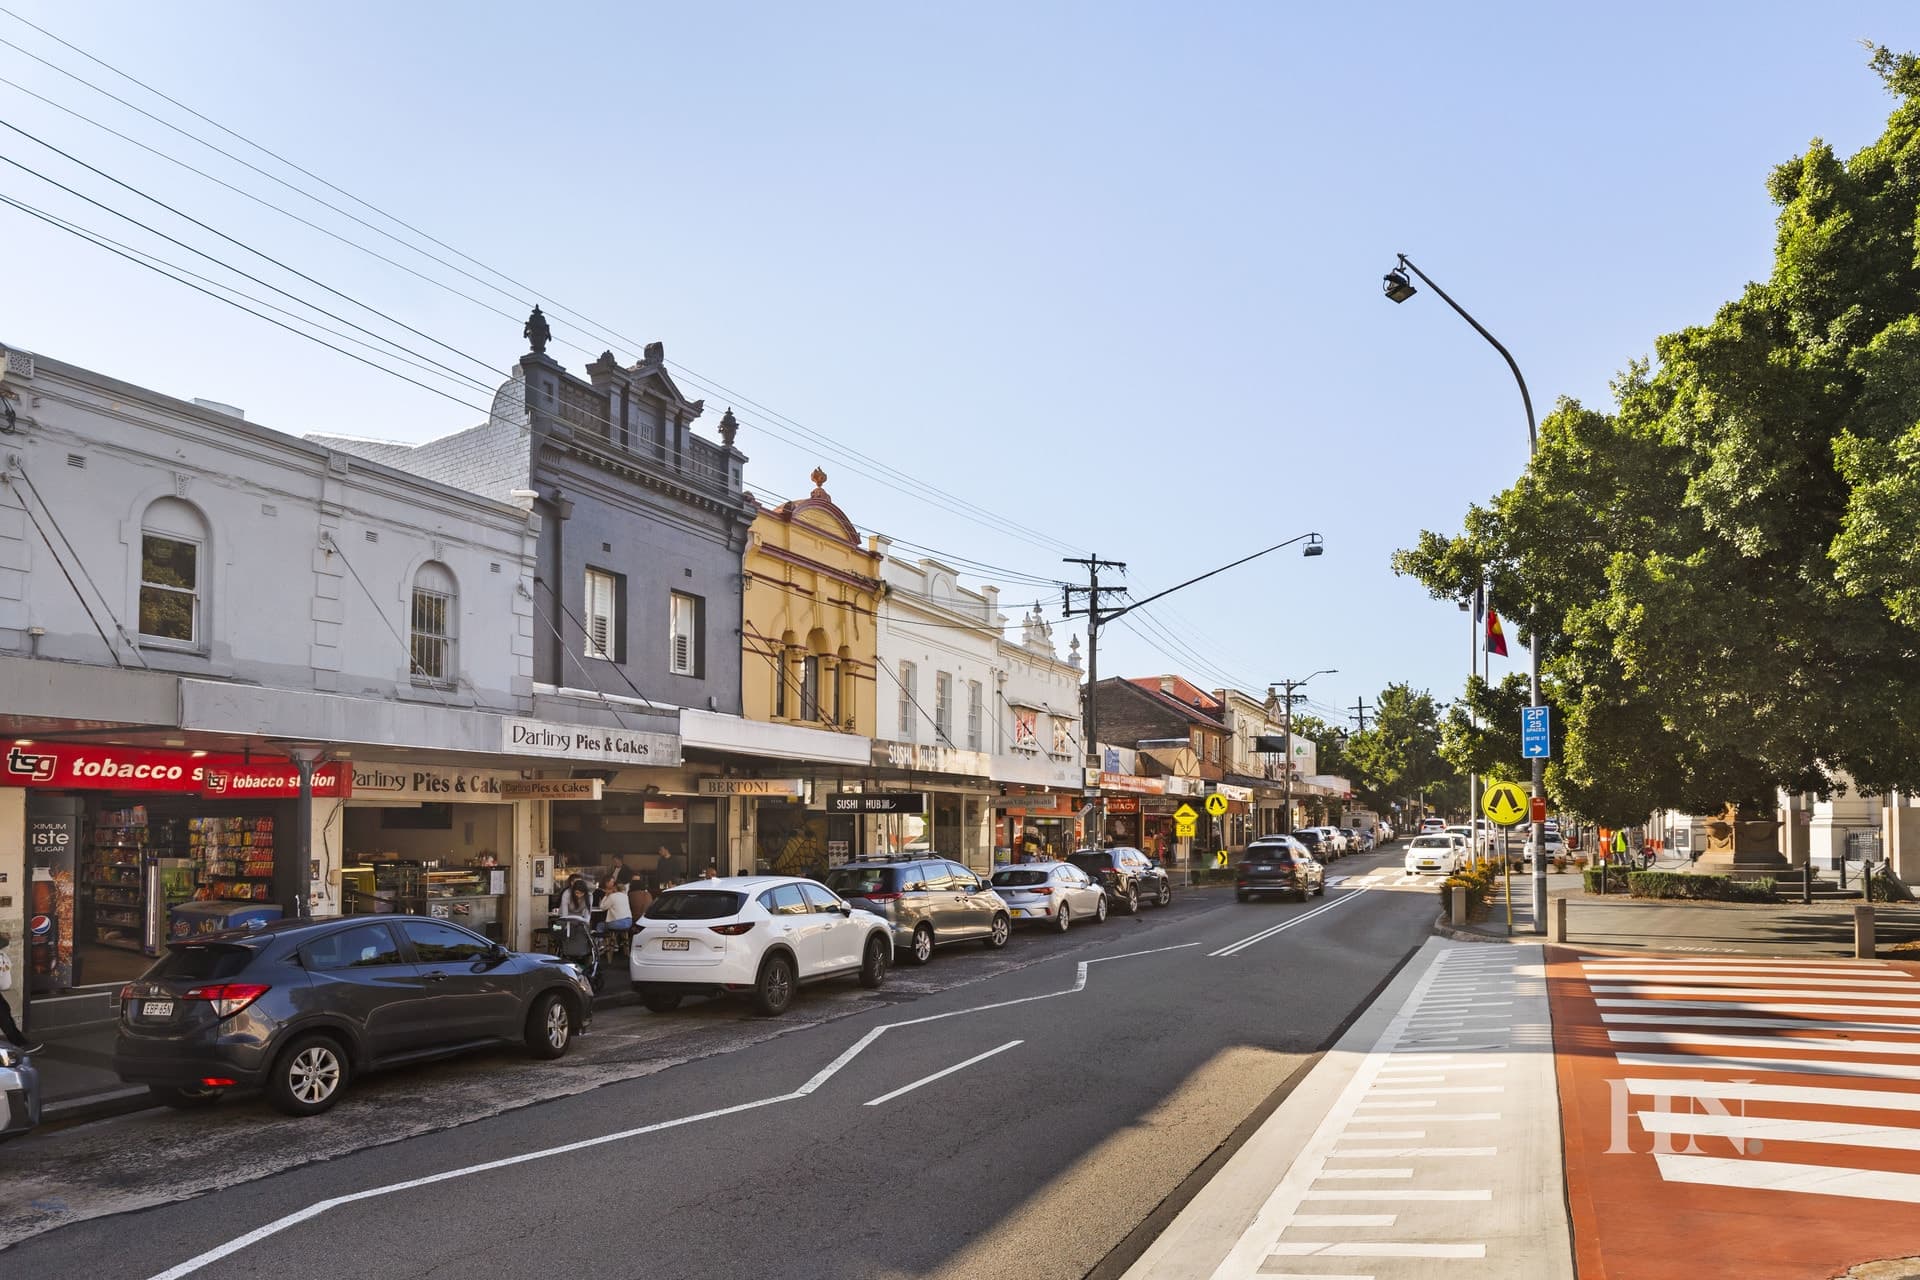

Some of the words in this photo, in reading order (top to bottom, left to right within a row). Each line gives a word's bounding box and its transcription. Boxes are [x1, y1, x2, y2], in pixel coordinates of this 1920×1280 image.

[1527, 709, 1544, 720] 2P
[513, 725, 570, 751] Darling
[576, 734, 600, 751] Pies
[604, 737, 612, 751] &
[616, 738, 649, 755] Cakes
[7, 747, 57, 781] tsg
[72, 757, 182, 780] tobacco
[888, 745, 912, 765] SUSHI
[920, 749, 936, 768] HUB
[208, 772, 227, 793] tsg
[232, 775, 284, 789] tobacco
[288, 773, 335, 787] sttion
[412, 772, 450, 792] Pies
[454, 775, 466, 793] &
[470, 775, 501, 793] Cak
[531, 783, 550, 792] Pies
[553, 784, 560, 792] &
[562, 782, 590, 792] Cakes
[708, 781, 768, 793] BERTONI
[837, 799, 858, 809] SUSHI
[866, 799, 881, 809] HUB
